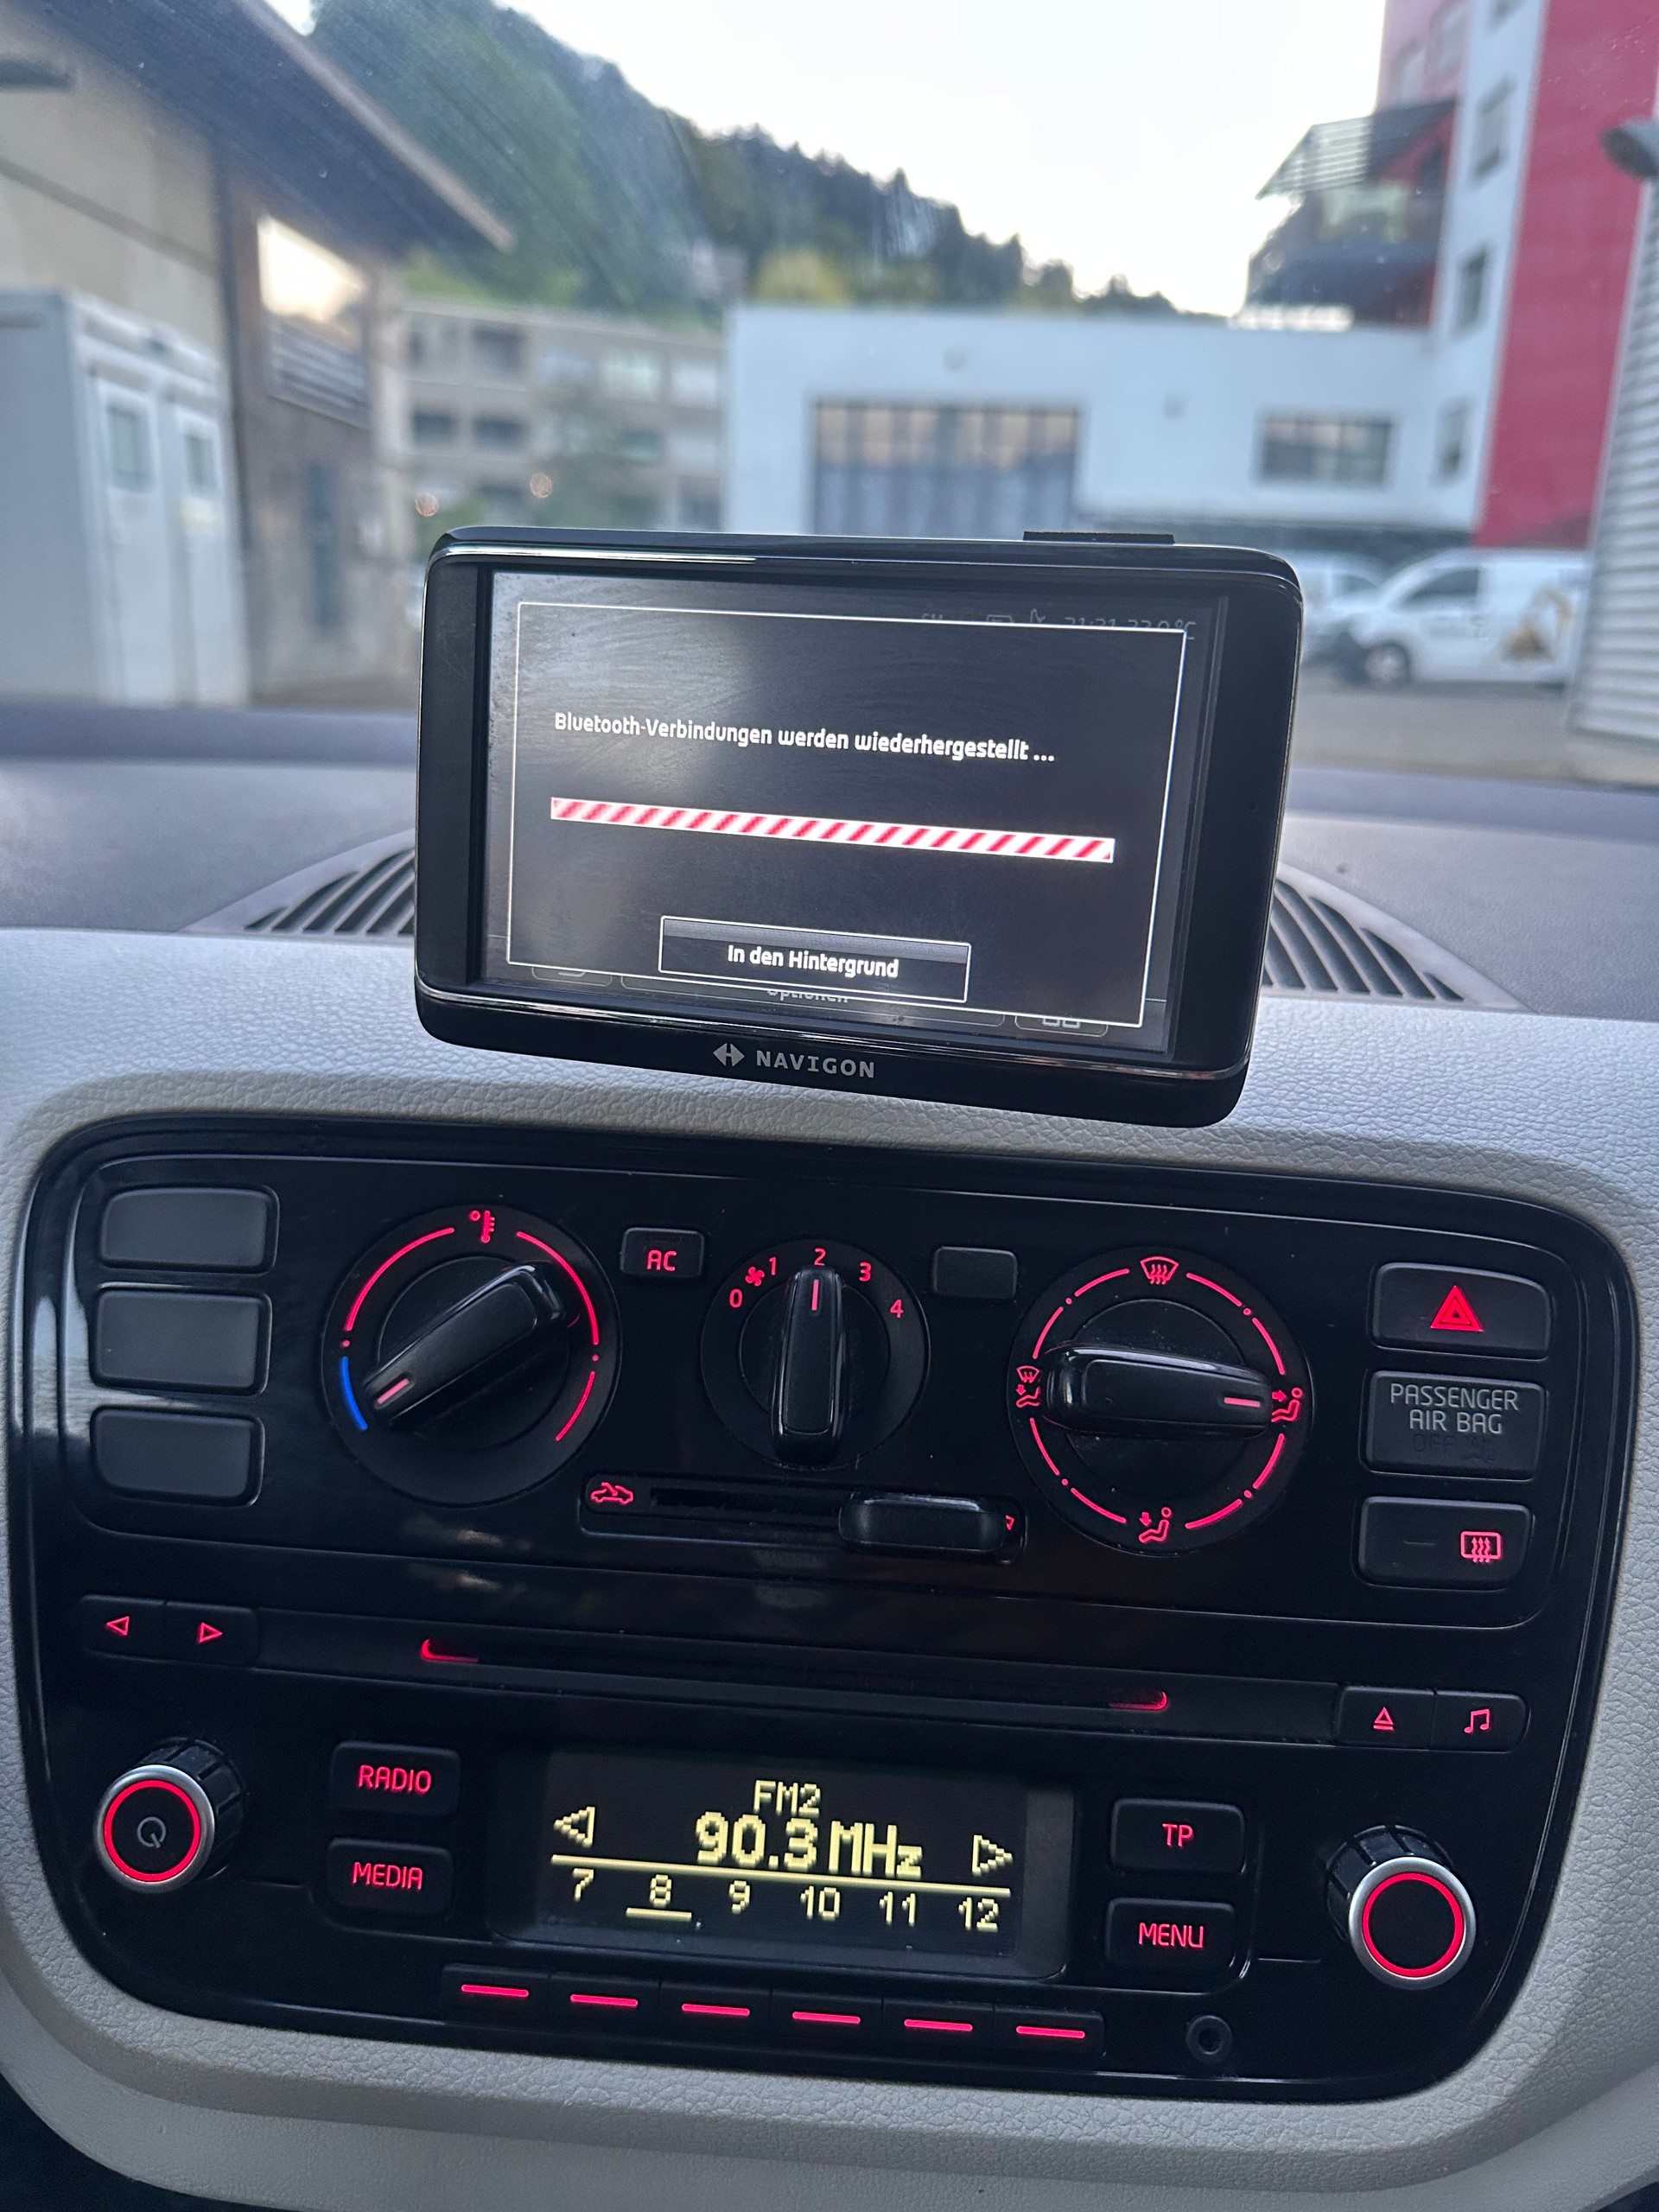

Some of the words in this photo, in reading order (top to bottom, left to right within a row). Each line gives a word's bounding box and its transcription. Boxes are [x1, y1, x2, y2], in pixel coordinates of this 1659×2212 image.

[555, 712, 772, 747] Bluetooth-Verbindungen
[778, 728, 849, 749] werden
[854, 731, 1029, 761] wiederhergestellt
[728, 944, 746, 963] In
[749, 945, 784, 967] den
[788, 950, 899, 978] Hintergrund
[755, 1049, 875, 1079] NAVIGON
[646, 1249, 677, 1272] AC
[769, 1256, 777, 1276] 1
[814, 1248, 826, 1266] 2
[859, 1262, 872, 1282] 3
[729, 1288, 743, 1308] 0
[890, 1299, 904, 1319] 4
[1390, 1382, 1520, 1411] PASSENGER
[1409, 1408, 1448, 1432] AIR
[1456, 1409, 1503, 1435] BAG
[358, 1764, 432, 1795] RADIO
[753, 1779, 821, 1815] FM2
[1161, 1823, 1193, 1847] TP
[352, 1861, 423, 1891] MEDIA
[572, 1867, 594, 1901] 7
[649, 1873, 672, 1907] 8
[728, 1879, 751, 1914] 9
[800, 1885, 841, 1920] 10
[879, 1889, 920, 1927] 11
[958, 1897, 999, 1932] 12
[1138, 1922, 1205, 1948] MENU
